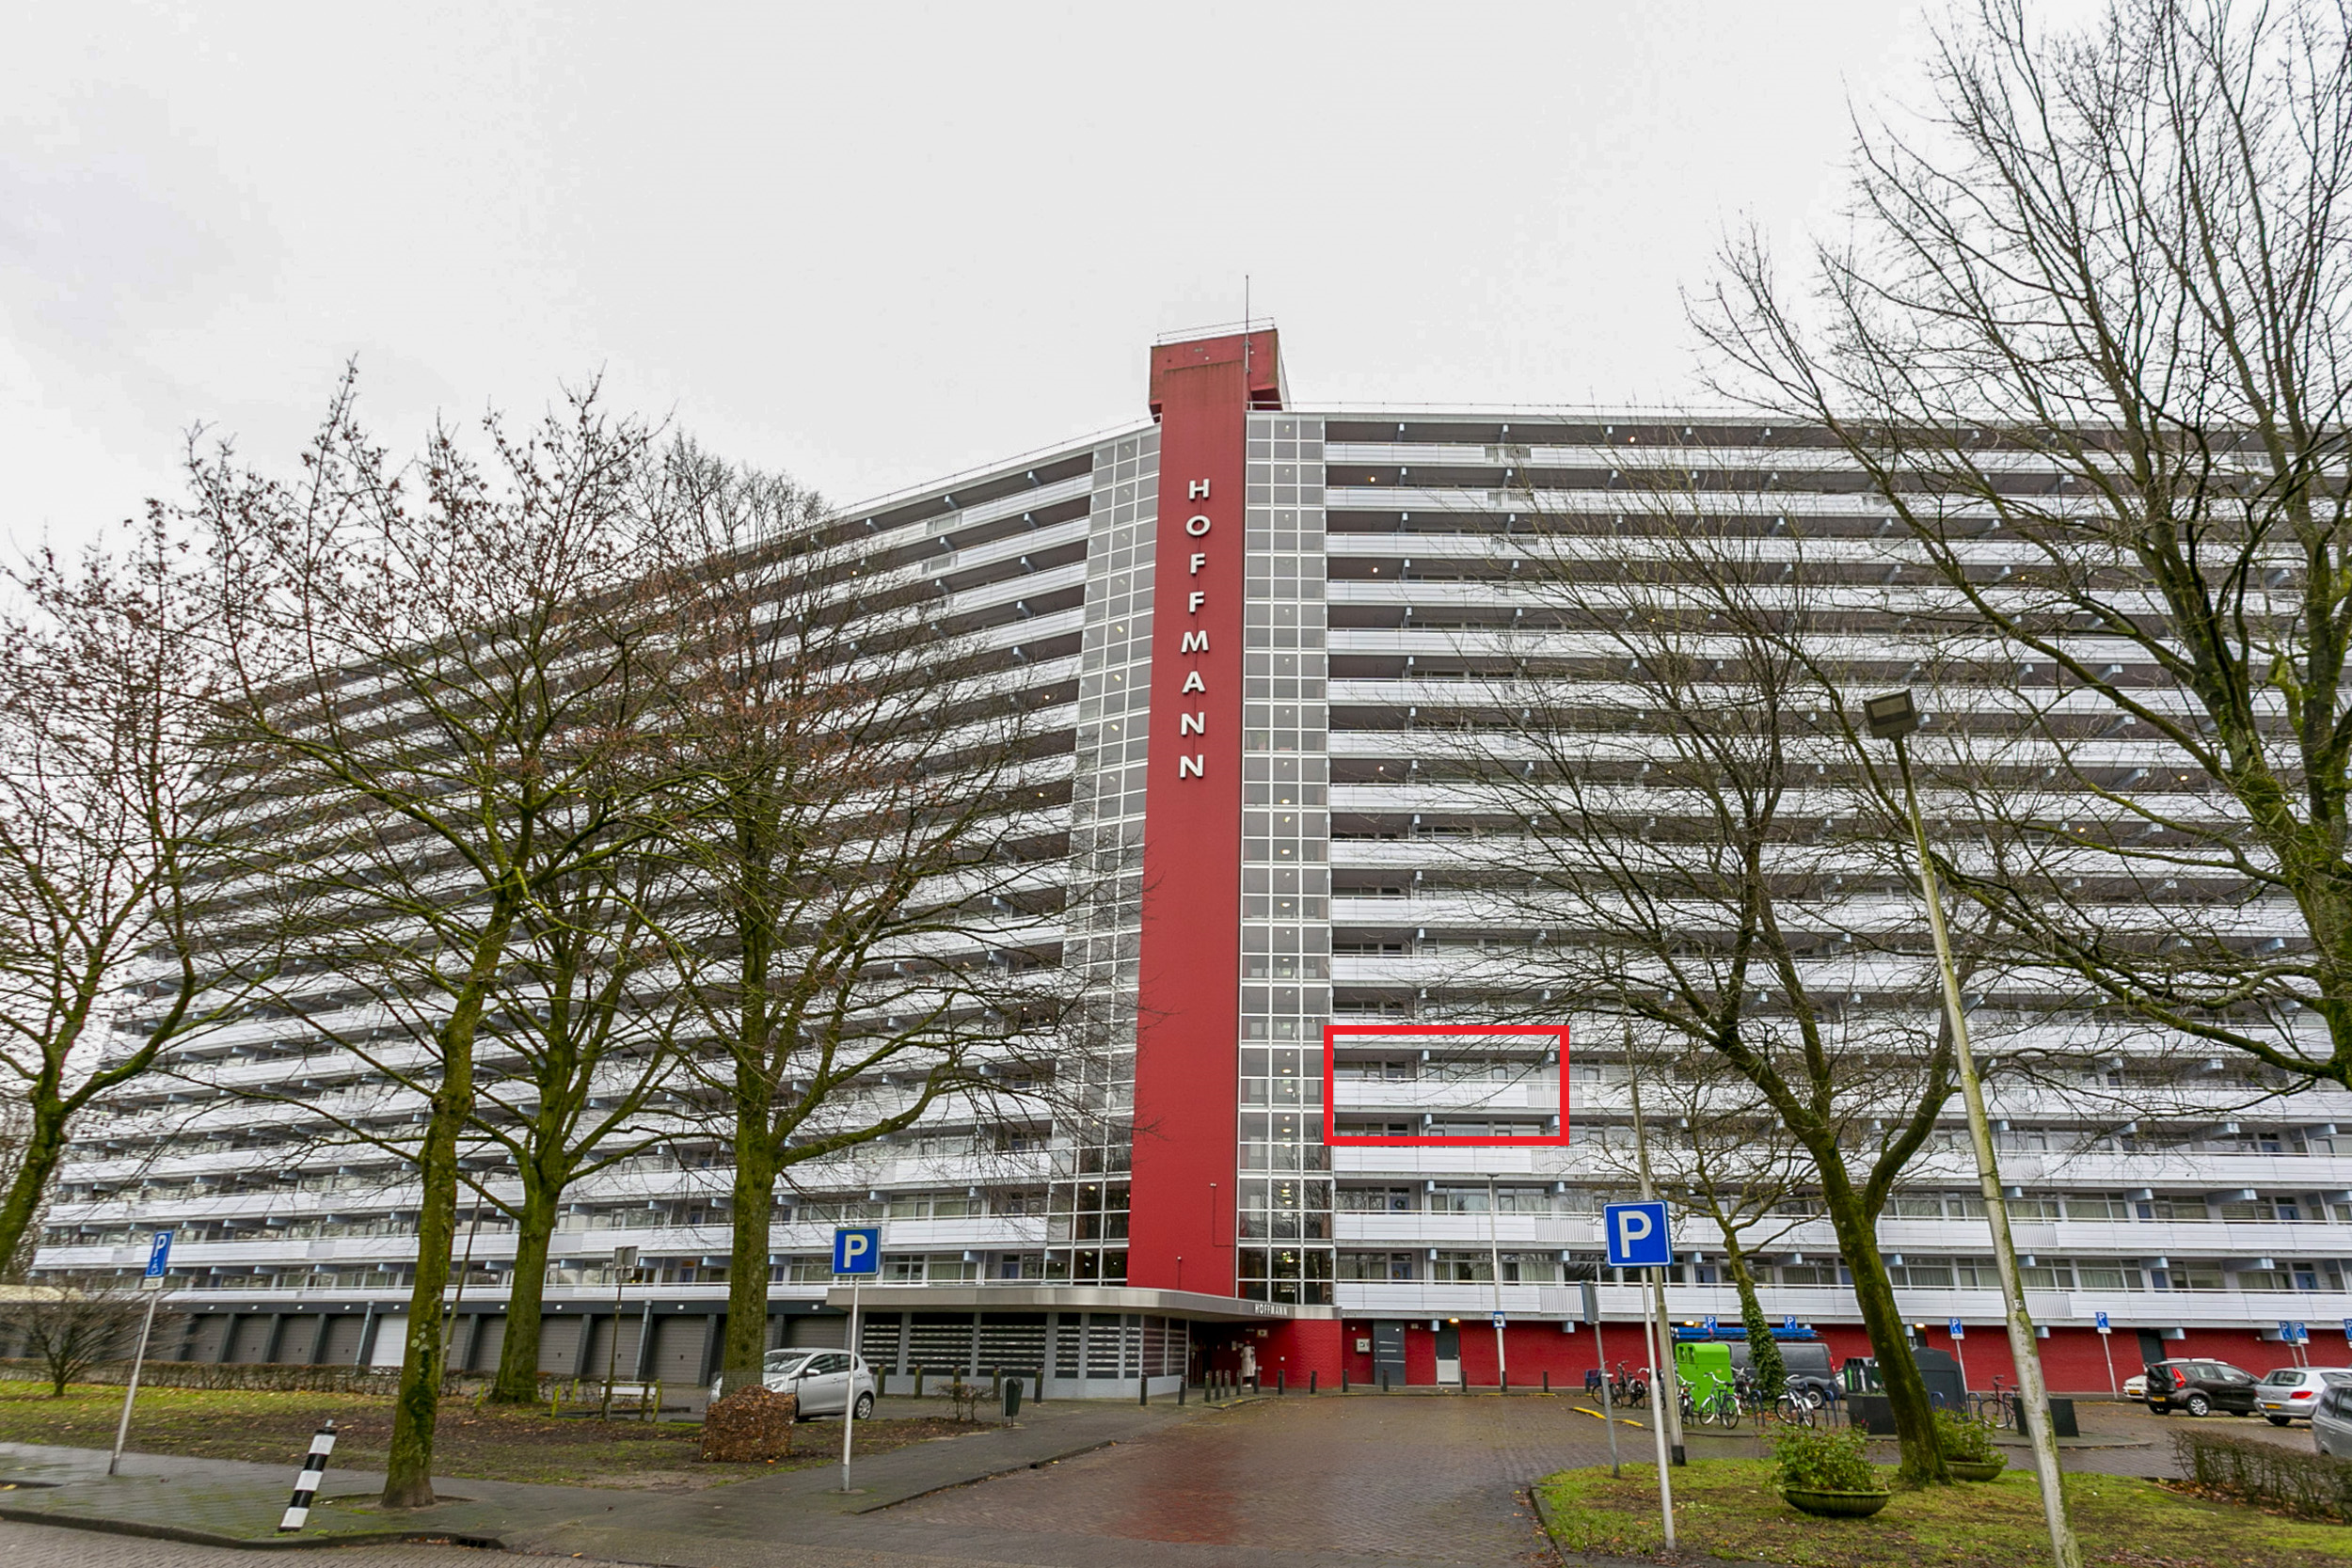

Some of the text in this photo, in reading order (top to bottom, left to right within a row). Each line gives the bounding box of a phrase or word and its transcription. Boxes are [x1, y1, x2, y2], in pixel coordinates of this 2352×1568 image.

[1179, 478, 1211, 780] HOFFMANN
[153, 1234, 167, 1258] P
[843, 1234, 868, 1268] P
[1618, 1210, 1652, 1259] P
[1254, 1303, 1288, 1316] HOFFMANN
